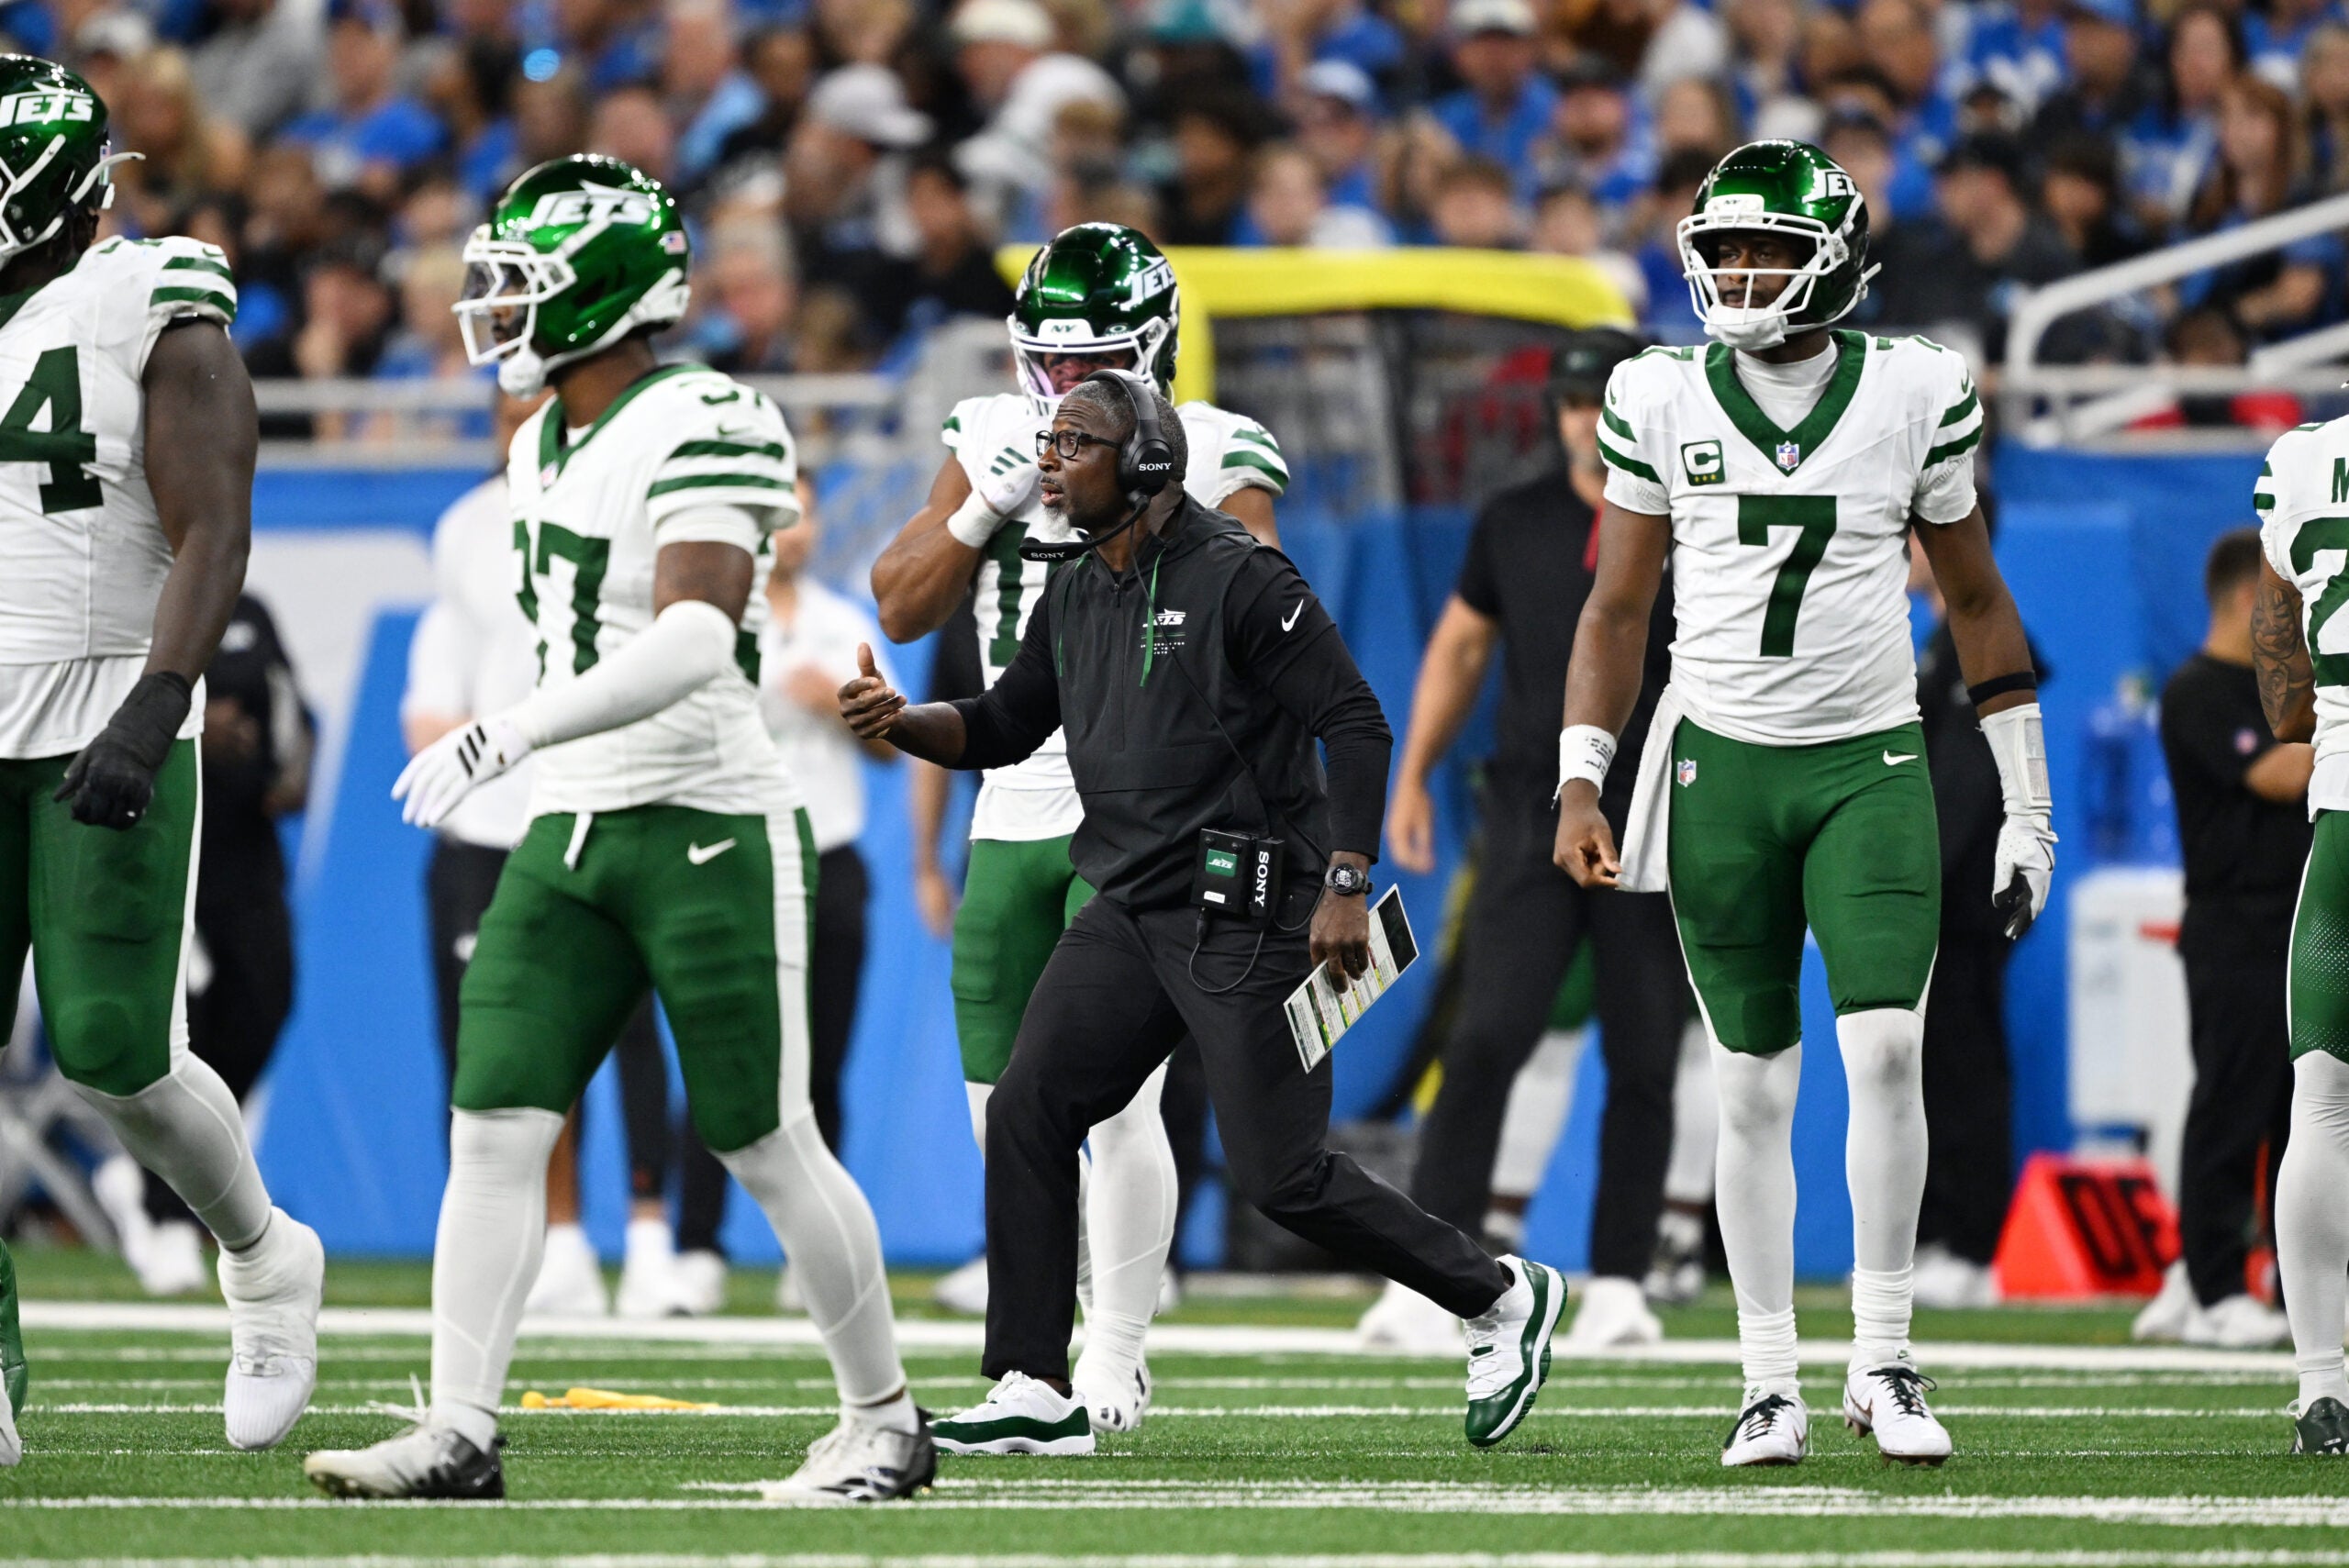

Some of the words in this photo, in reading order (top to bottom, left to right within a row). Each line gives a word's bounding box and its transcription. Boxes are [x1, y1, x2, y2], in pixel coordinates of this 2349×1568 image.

[1802, 158, 1857, 204] JET
[525, 180, 652, 231] JETS
[1138, 462, 1173, 472] SONY
[1684, 442, 1720, 475] C
[1030, 551, 1065, 560] SONY
[1737, 494, 1837, 657] 7
[1208, 858, 1234, 870] JETS
[1254, 851, 1270, 907] SONY
